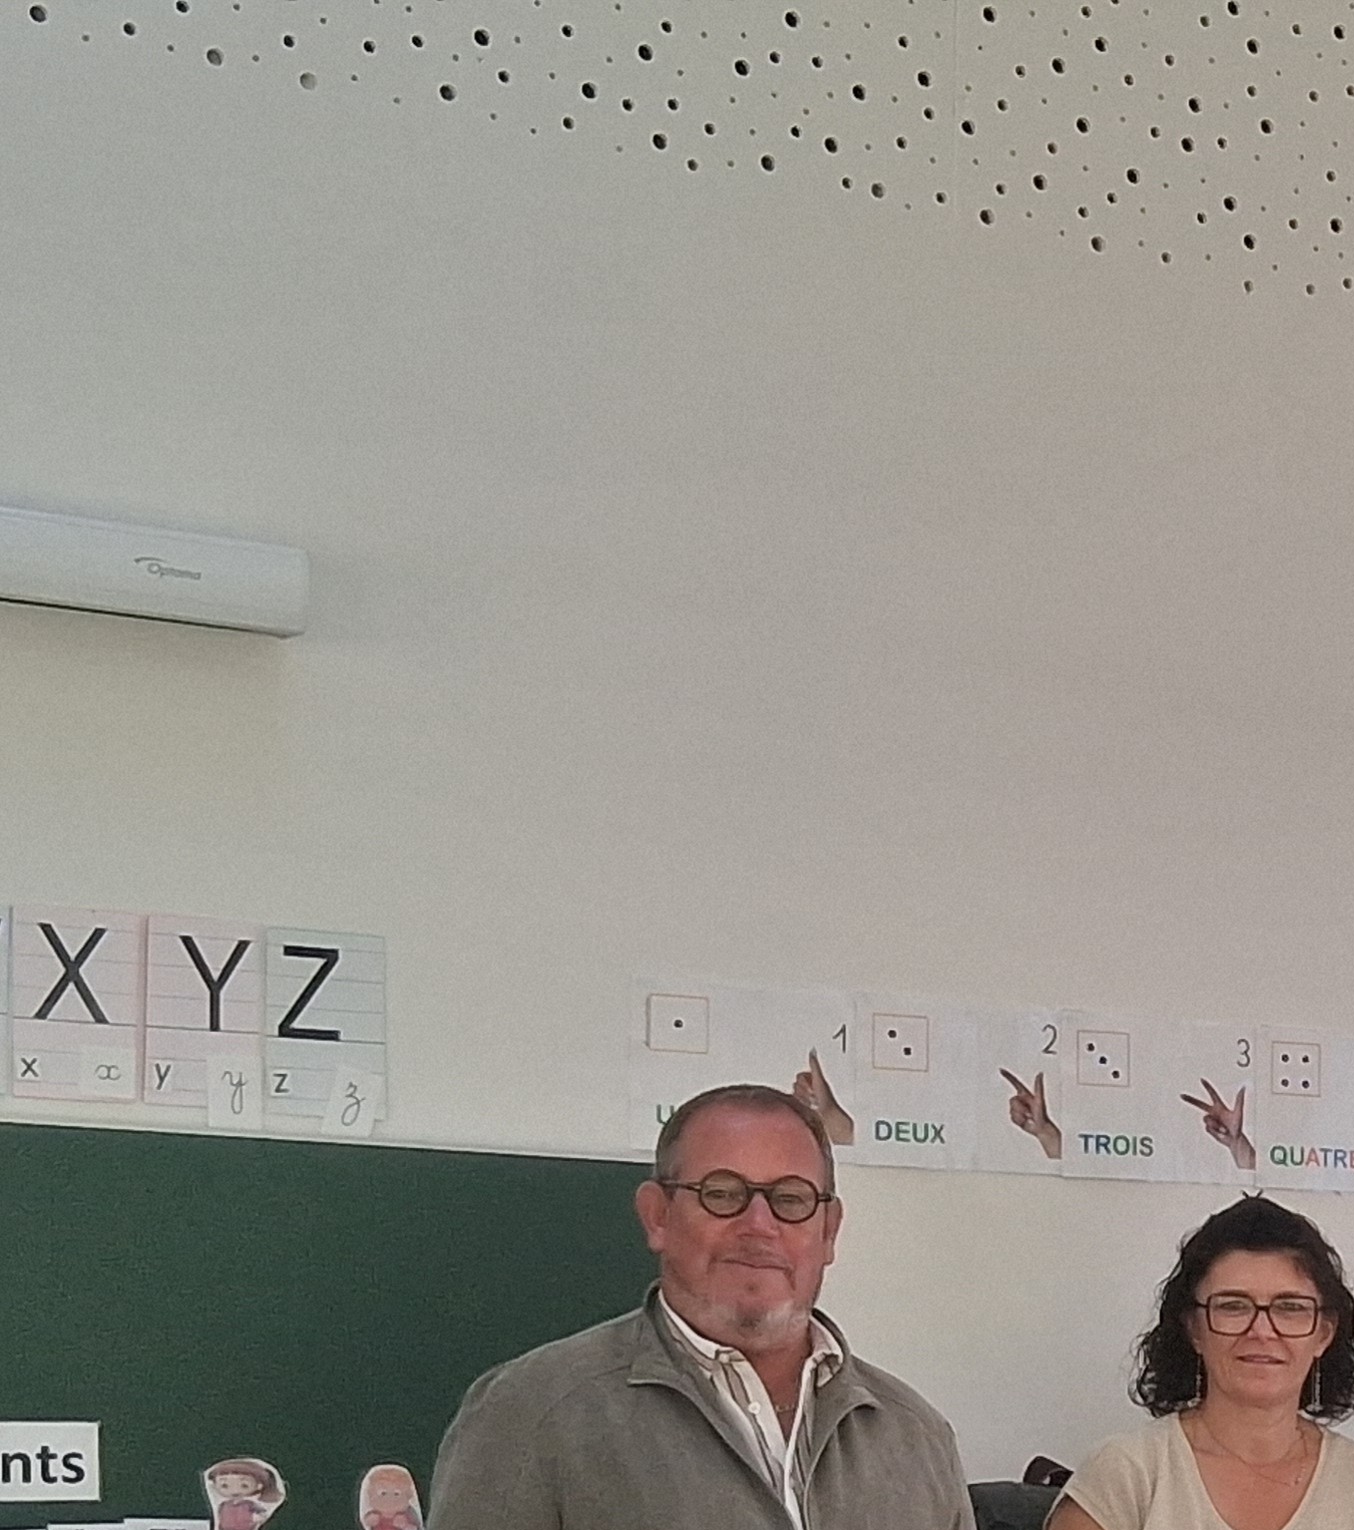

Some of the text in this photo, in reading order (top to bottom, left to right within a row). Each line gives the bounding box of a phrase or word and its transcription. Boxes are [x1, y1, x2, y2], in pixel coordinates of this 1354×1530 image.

[147, 562, 201, 581] Optoma
[34, 922, 341, 1041] X Y Z
[832, 1024, 847, 1053] 1
[1041, 1024, 1058, 1055] 2
[1236, 1038, 1251, 1068] 3
[20, 1056, 39, 1078] x
[155, 1063, 172, 1090] y
[875, 1119, 945, 1144] DEUX
[1079, 1133, 1154, 1157] TROIS
[1, 1445, 86, 1485] nts
